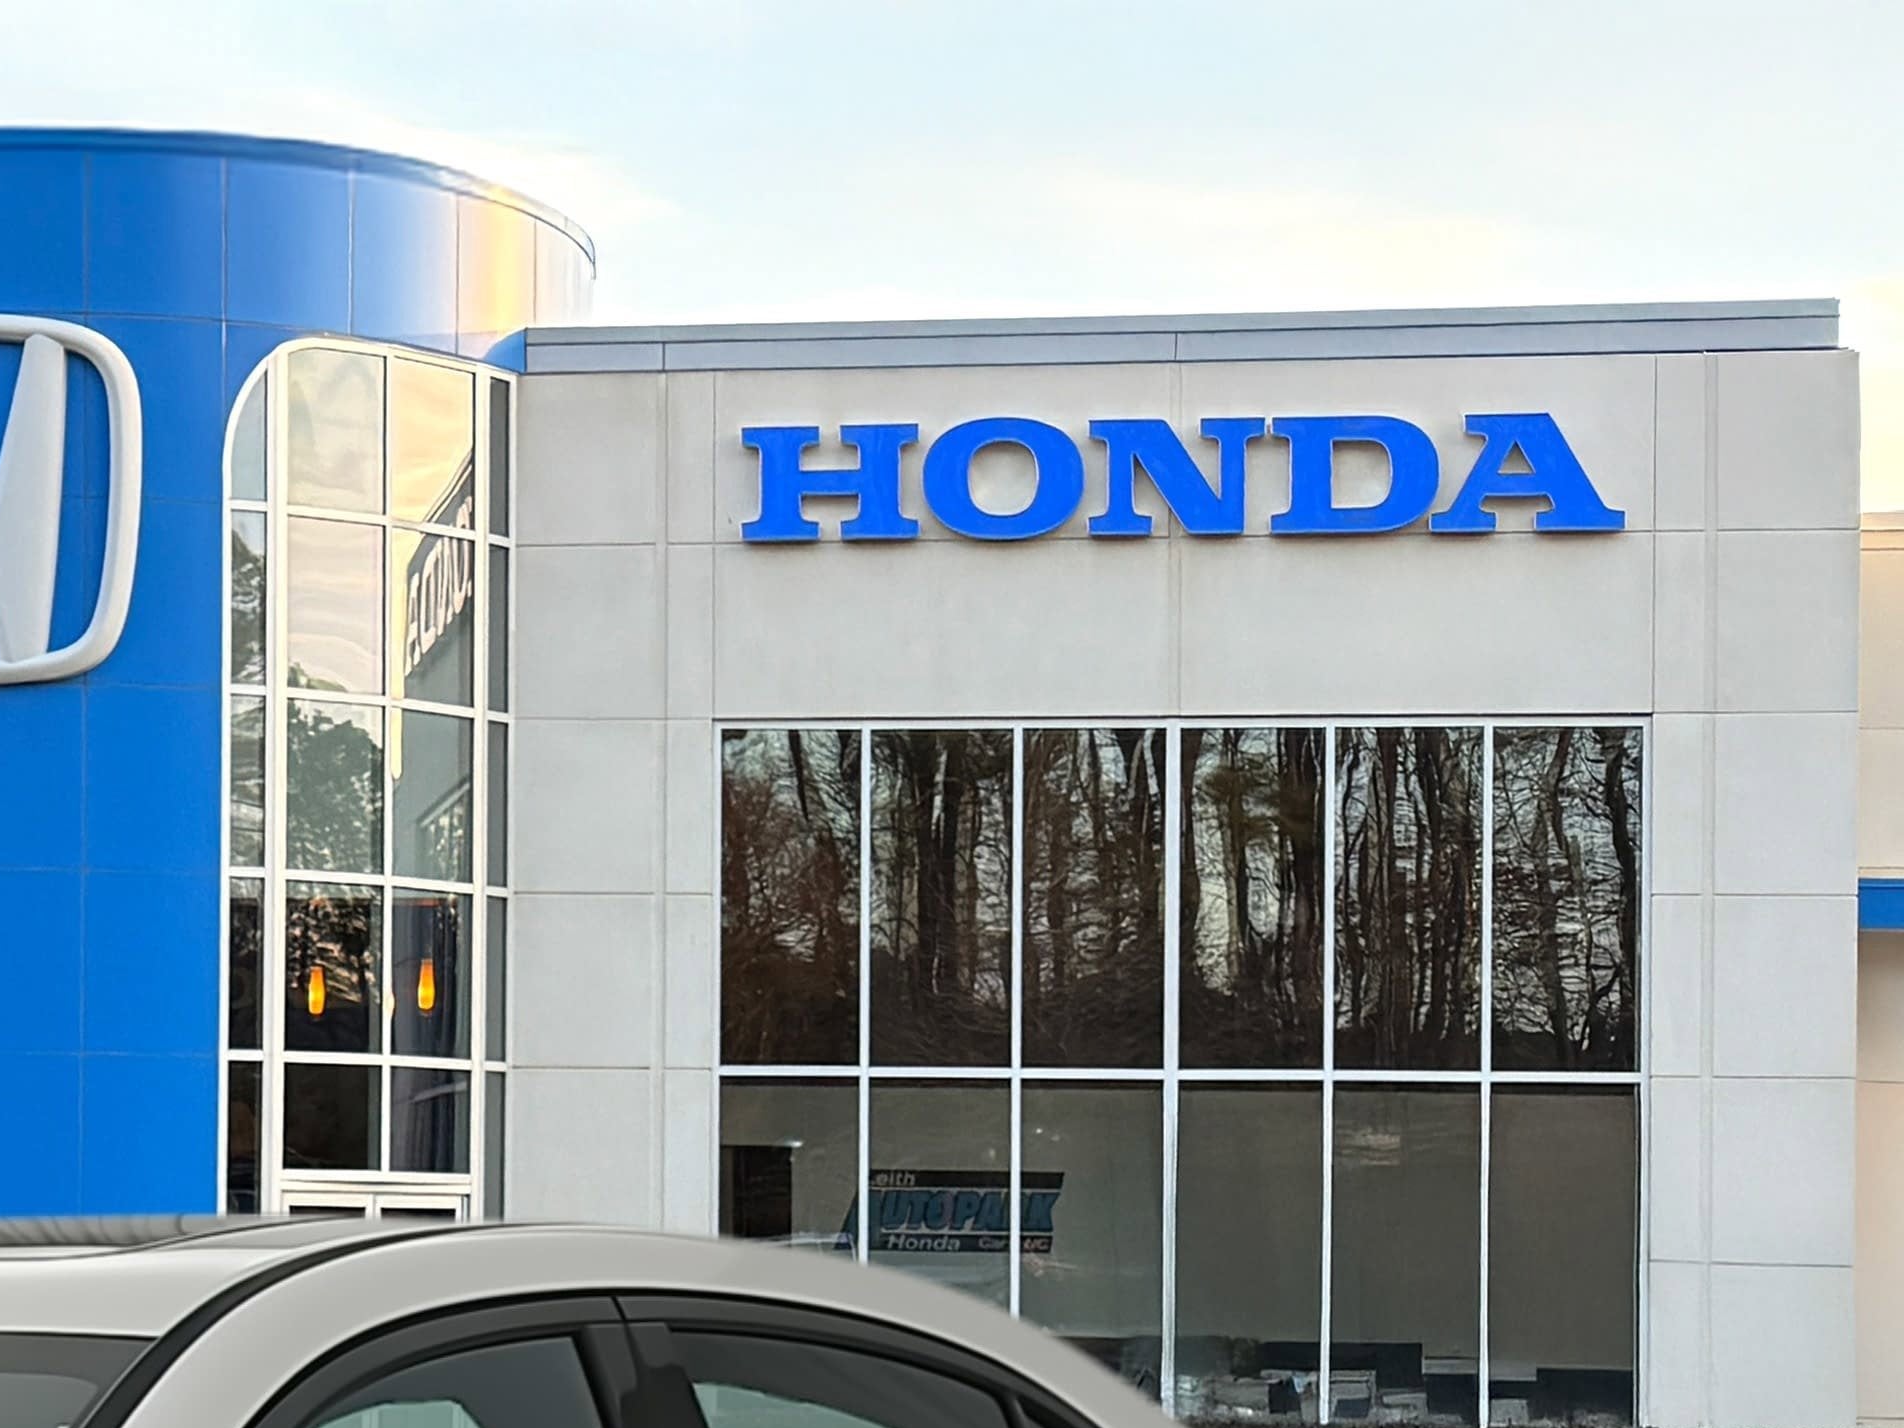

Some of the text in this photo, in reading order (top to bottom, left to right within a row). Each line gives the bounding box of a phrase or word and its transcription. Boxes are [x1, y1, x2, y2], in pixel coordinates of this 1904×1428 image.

[739, 412, 1627, 541] HONDA
[871, 1170, 916, 1187] eith
[886, 1235, 961, 1251] Honda
